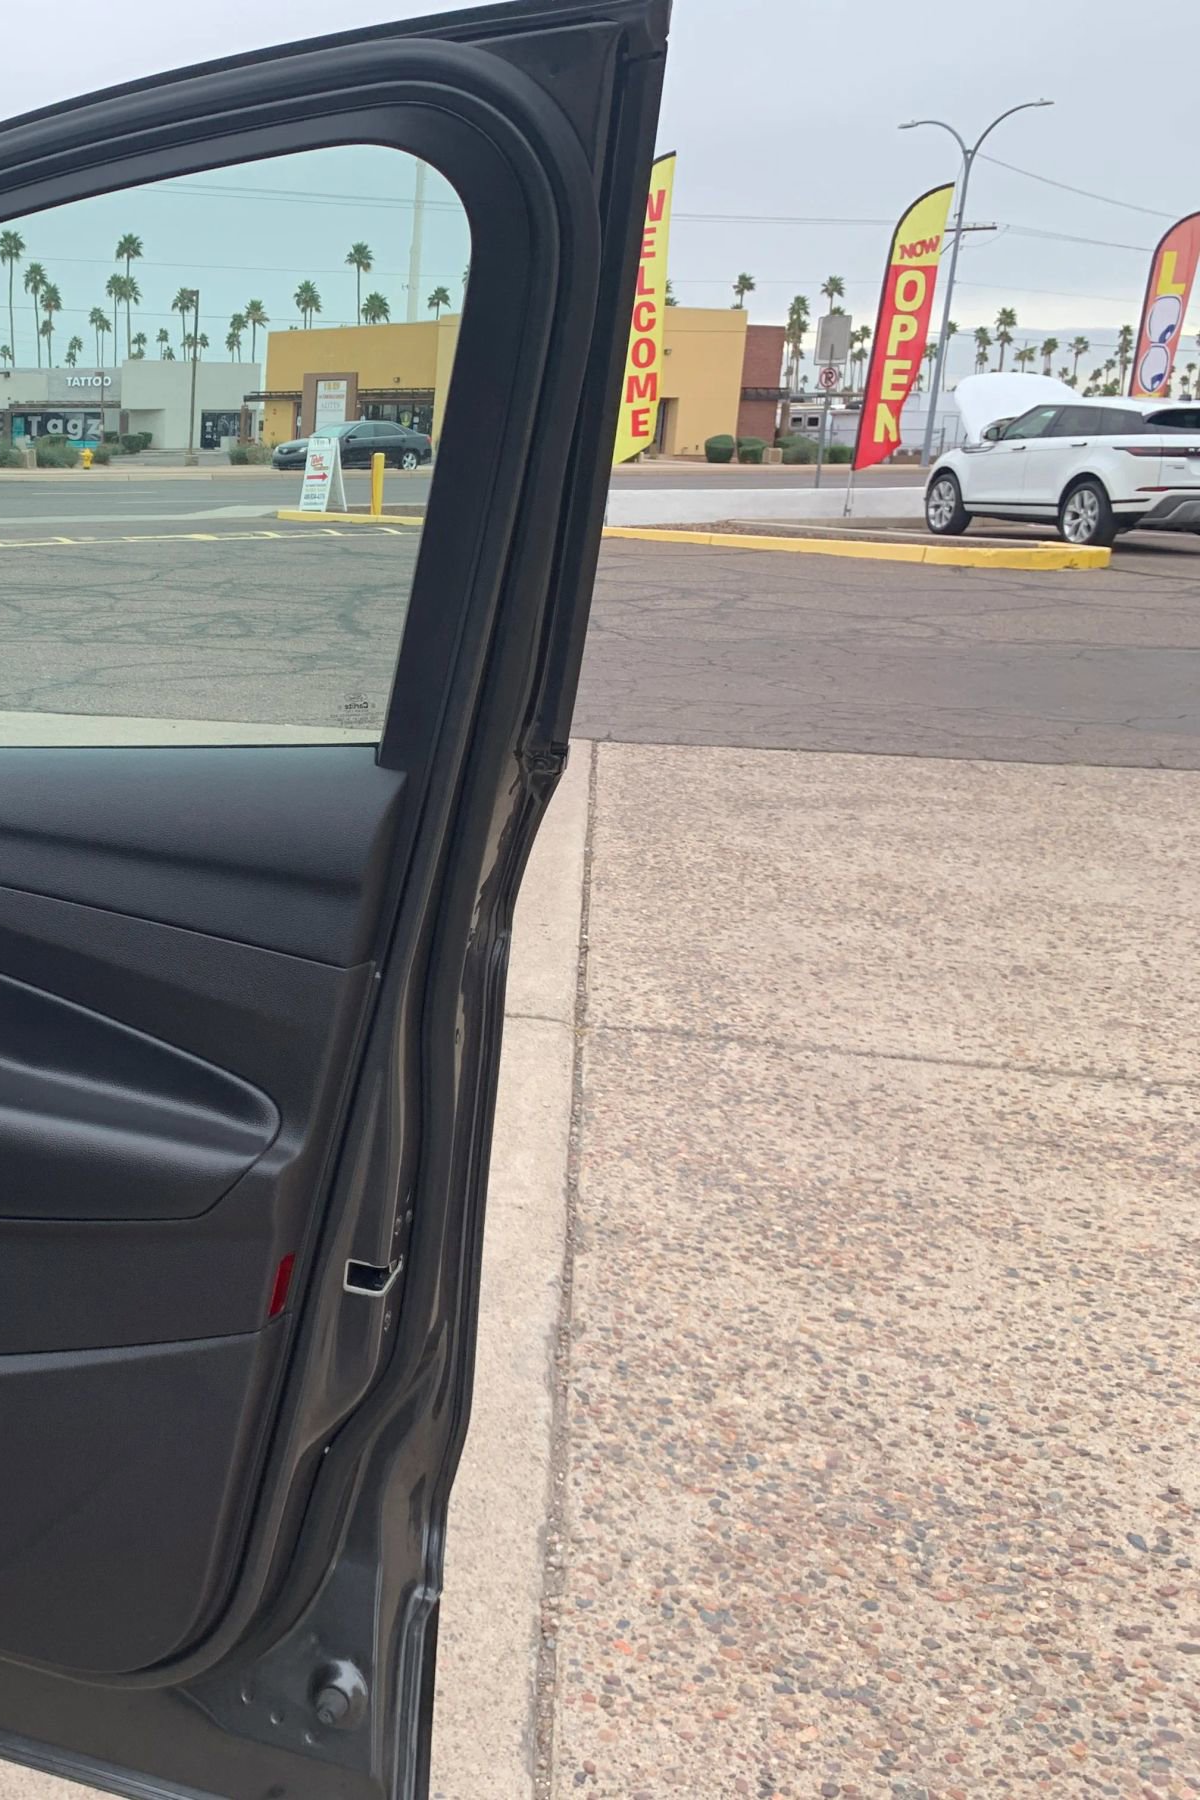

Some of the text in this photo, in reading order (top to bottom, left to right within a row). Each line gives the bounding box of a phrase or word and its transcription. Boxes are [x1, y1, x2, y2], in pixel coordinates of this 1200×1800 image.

[899, 235, 940, 260] NOW
[873, 269, 926, 443] OPEN
[66, 376, 112, 387] TATTOO
[27, 414, 103, 440] Tagz
